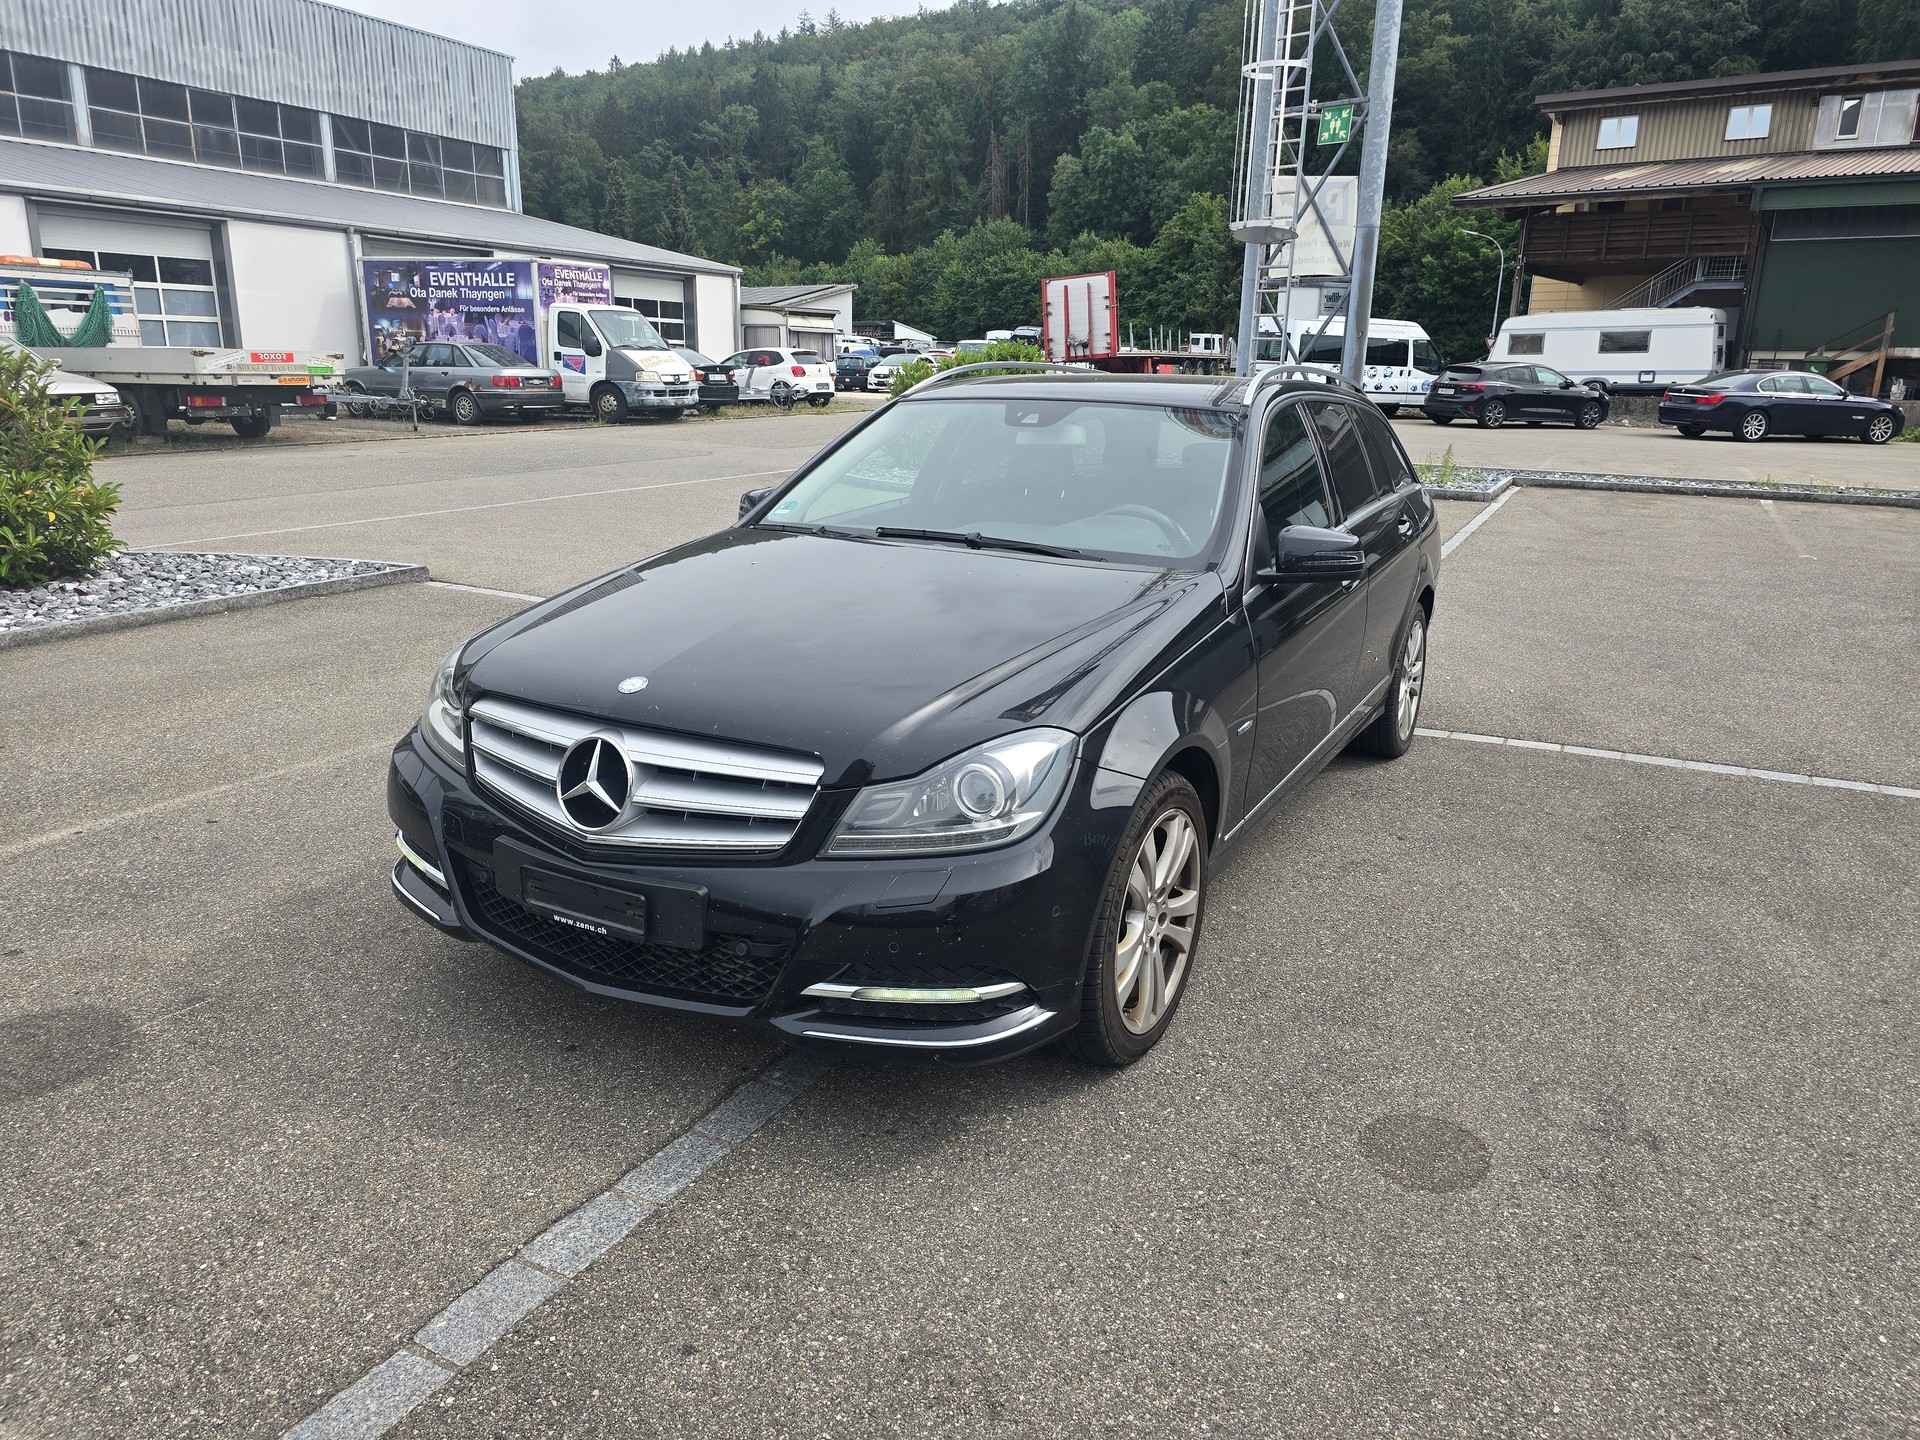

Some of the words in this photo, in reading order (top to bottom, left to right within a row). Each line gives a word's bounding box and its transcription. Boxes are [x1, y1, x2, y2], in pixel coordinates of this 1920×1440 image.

[429, 271, 515, 287] EVENTHALLE
[554, 269, 603, 282] EVENTHALLE
[542, 277, 553, 286] Ota
[554, 278, 573, 288] Danek
[573, 279, 598, 290] Thayngen
[410, 287, 426, 298] Ota
[428, 287, 458, 299] Danek
[460, 287, 505, 302] Thayngen
[459, 304, 469, 312] Für
[469, 304, 500, 313] besondere
[501, 305, 525, 314] Anlässe
[553, 914, 607, 935] www.zenu.ch
